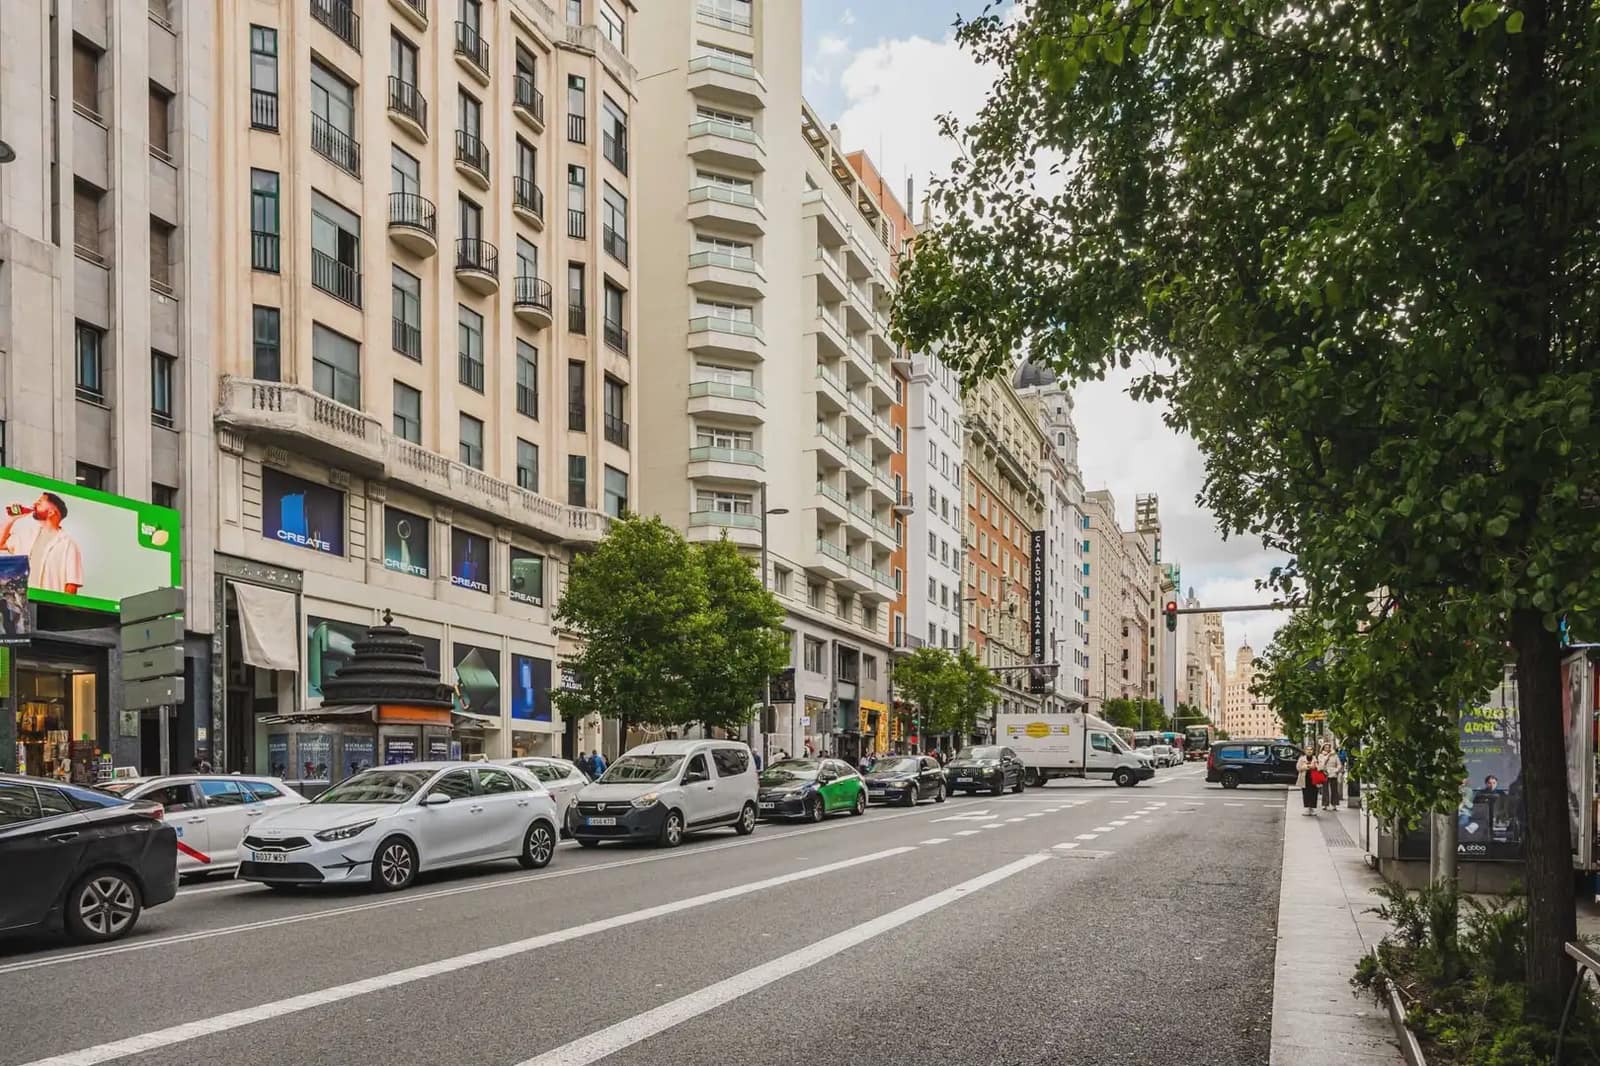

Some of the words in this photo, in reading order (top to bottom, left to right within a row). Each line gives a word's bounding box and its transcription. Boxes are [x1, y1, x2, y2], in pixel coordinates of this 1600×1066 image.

[277, 530, 331, 551] CREATE
[385, 558, 428, 577] CREATE
[451, 576, 488, 592] CREATE
[509, 591, 542, 605] CREATE
